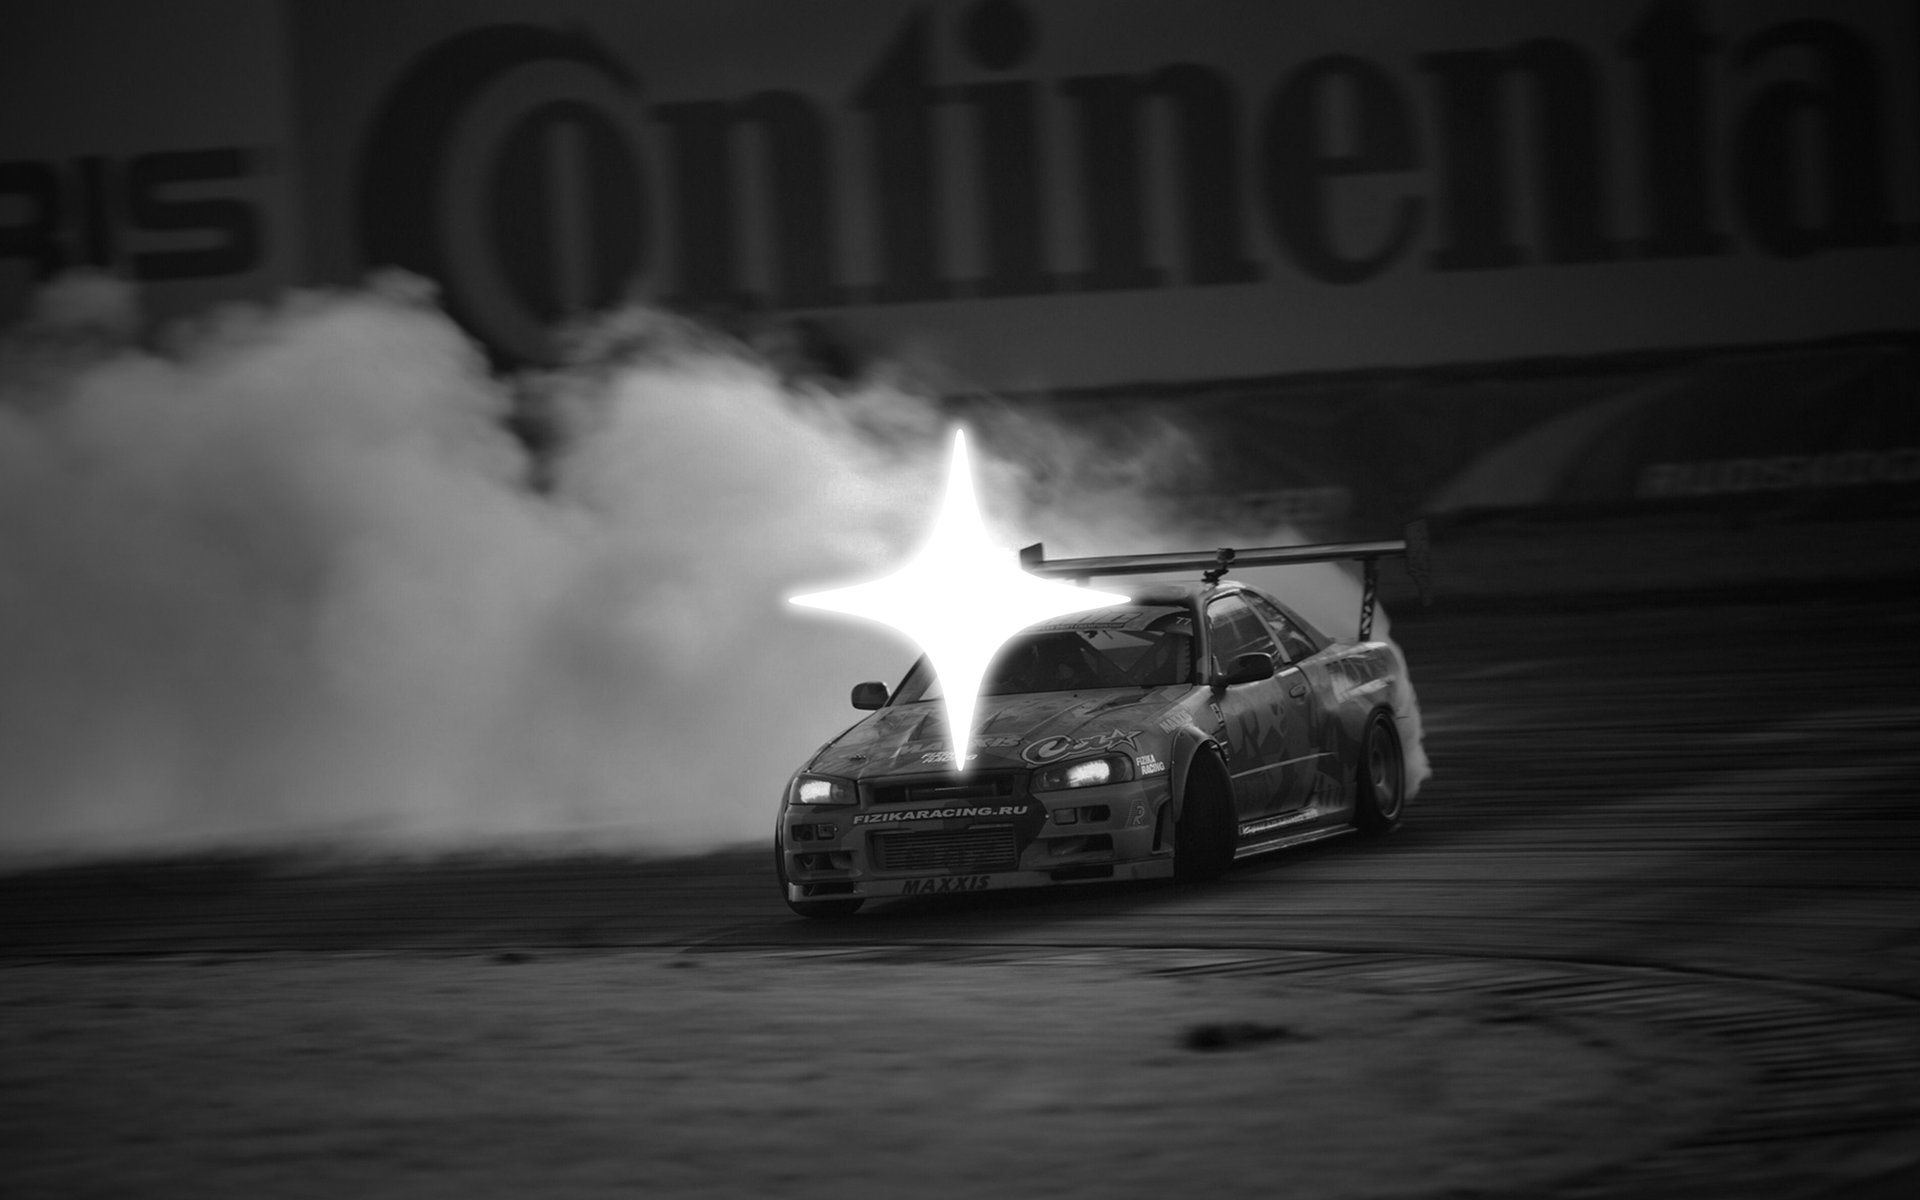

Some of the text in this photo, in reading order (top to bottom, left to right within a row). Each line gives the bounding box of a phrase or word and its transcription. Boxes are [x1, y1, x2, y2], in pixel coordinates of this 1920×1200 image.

[355, 0, 1920, 368] Continenta
[1141, 761, 1166, 776] RACING
[852, 805, 1029, 825] FIZIKARACING.RU
[902, 876, 992, 896] MAXXIS
